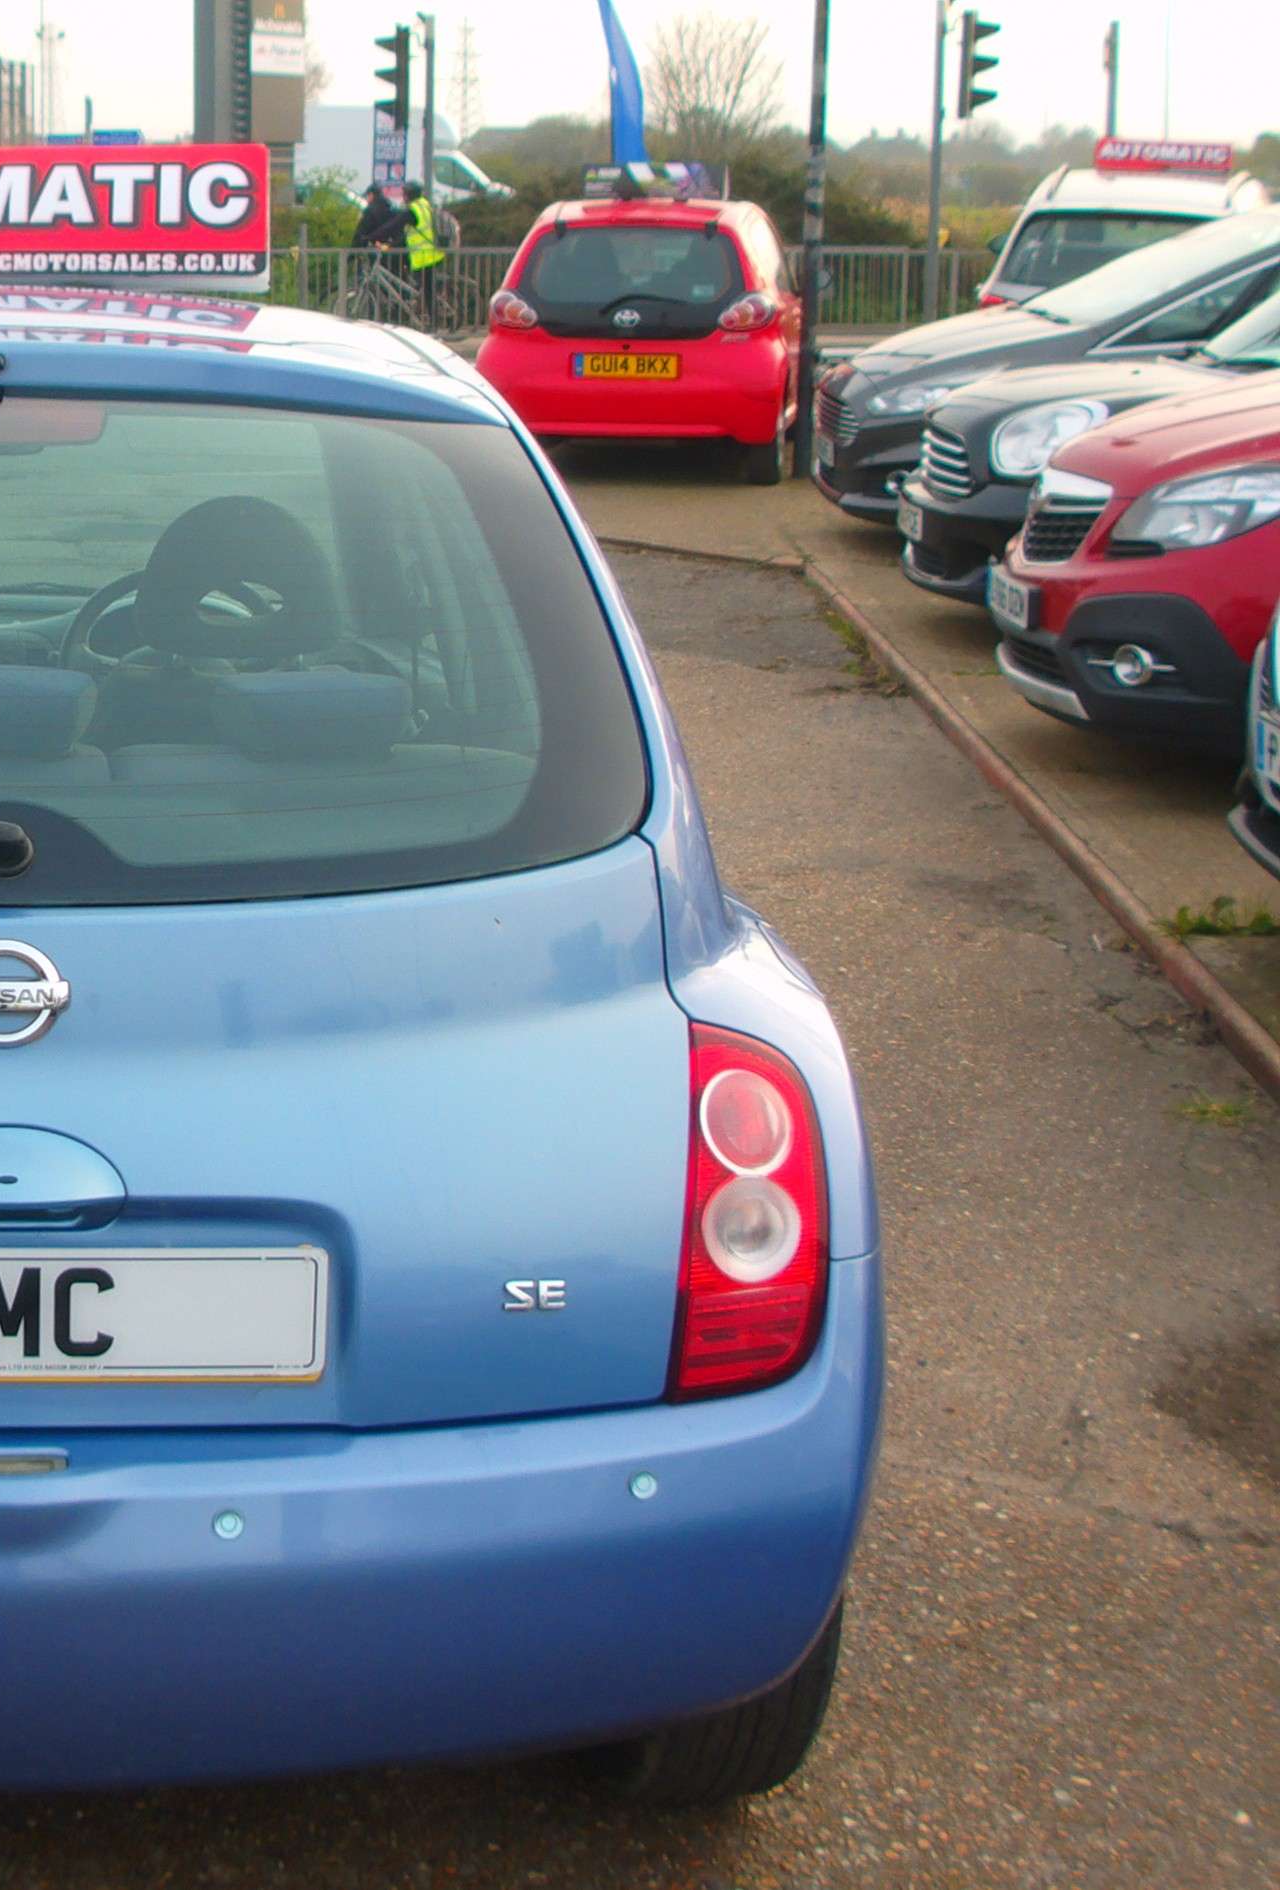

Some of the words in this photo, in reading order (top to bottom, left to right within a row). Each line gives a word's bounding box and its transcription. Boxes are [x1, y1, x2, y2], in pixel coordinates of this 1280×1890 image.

[1100, 142, 1229, 162] AUTOMATIC
[589, 356, 629, 373] GU14
[635, 356, 670, 374] BKX
[503, 1280, 567, 1310] SE
